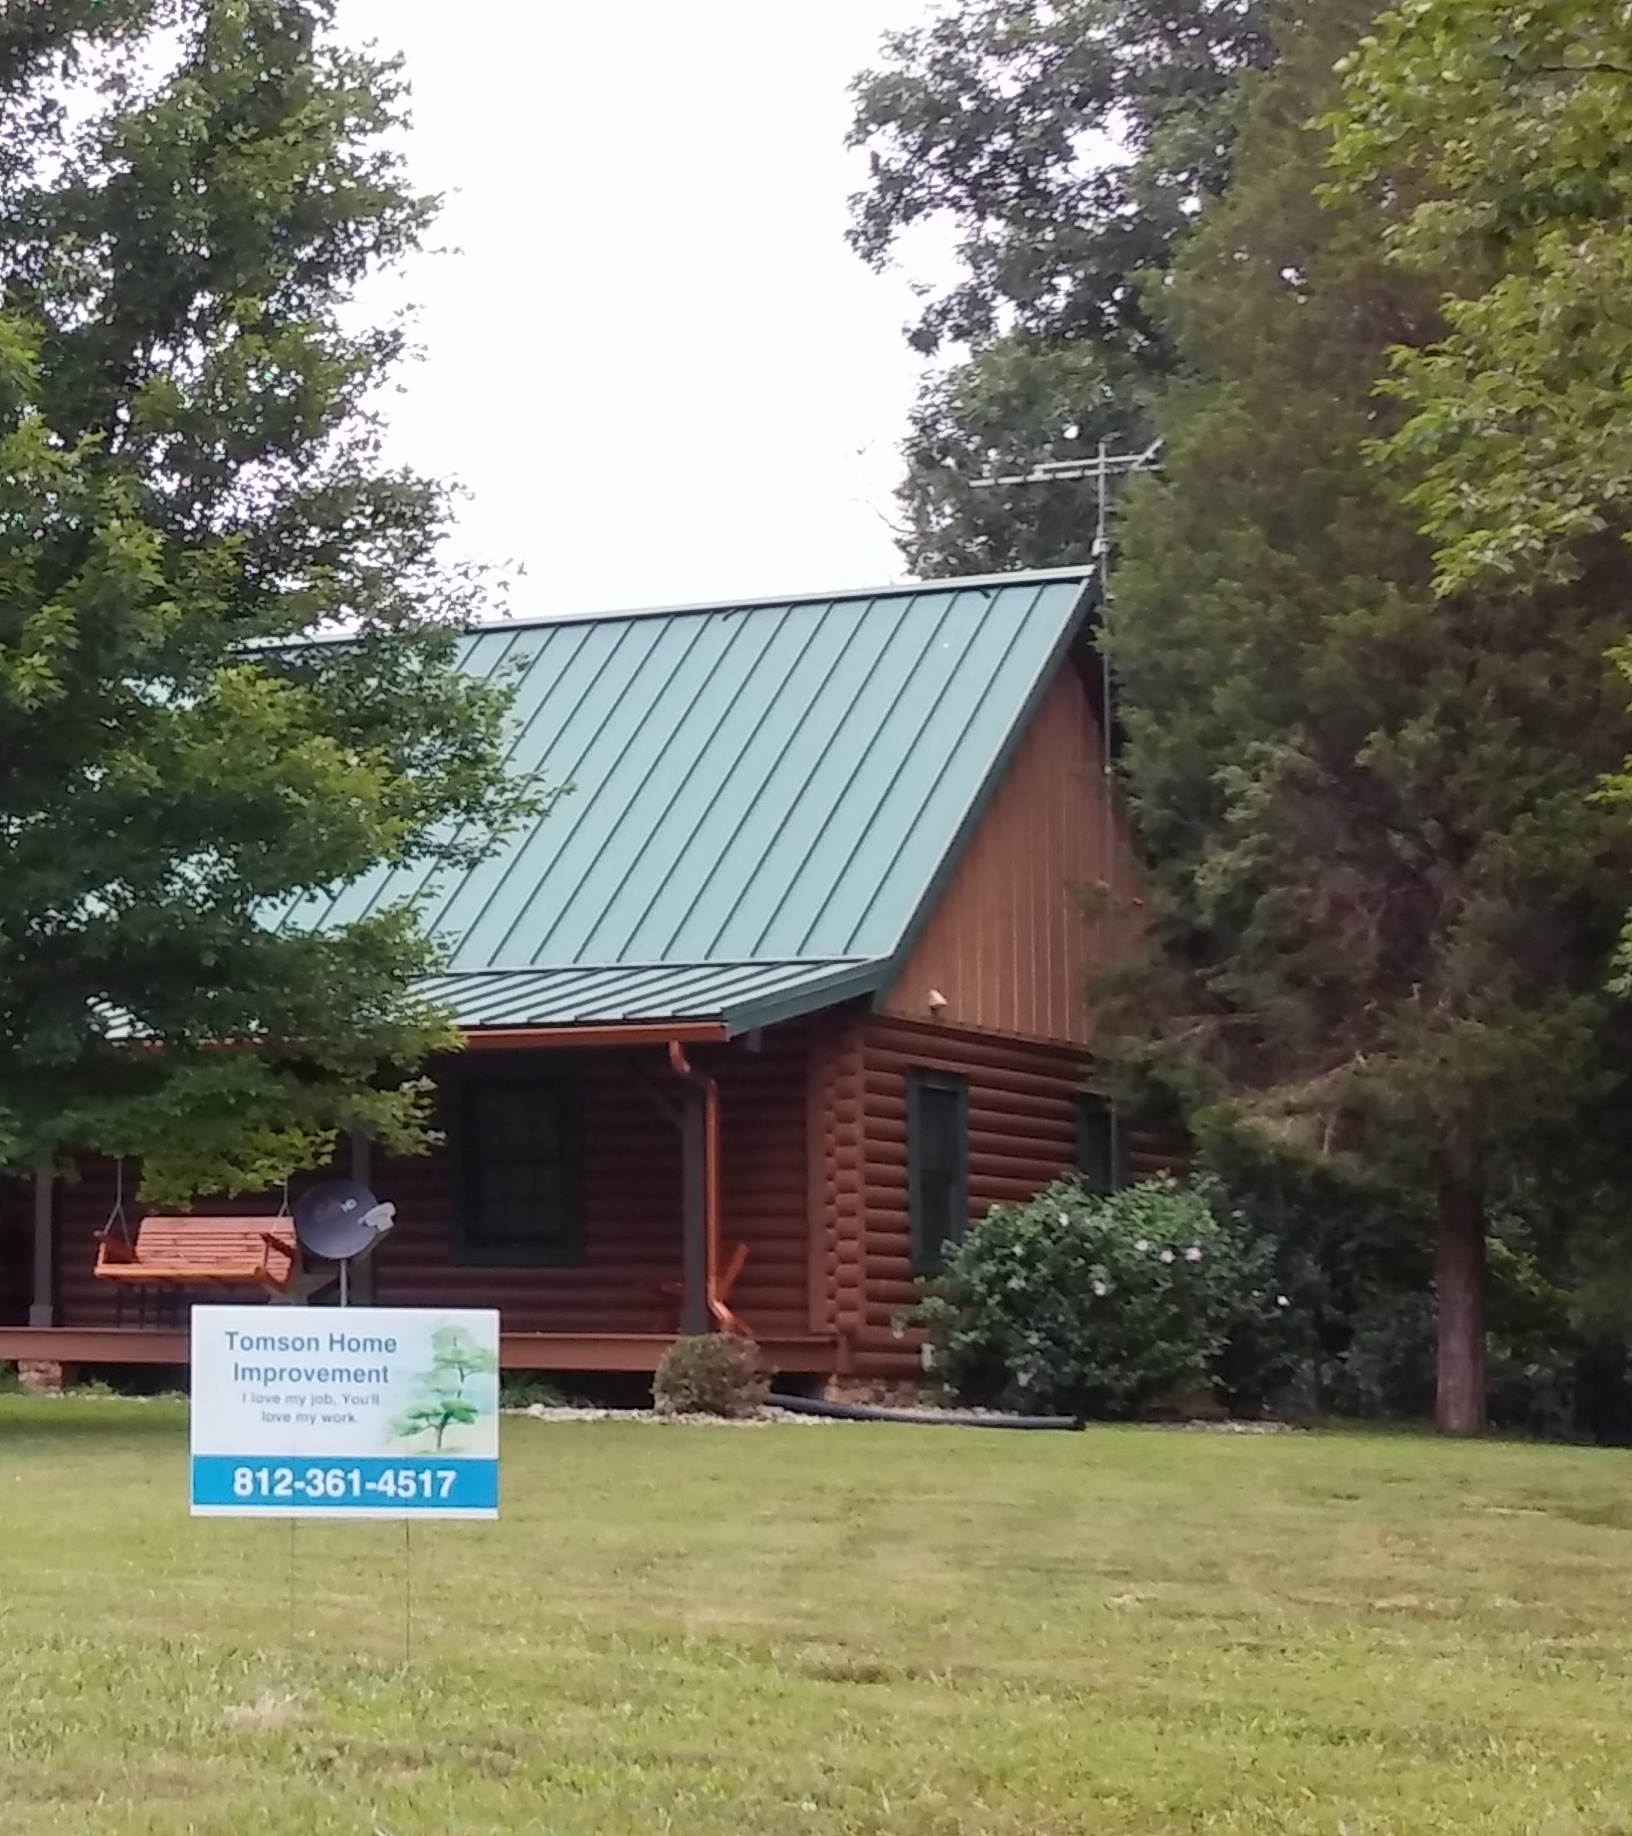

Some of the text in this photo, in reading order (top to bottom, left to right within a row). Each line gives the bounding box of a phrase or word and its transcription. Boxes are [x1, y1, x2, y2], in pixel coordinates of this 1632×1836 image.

[225, 1331, 397, 1353] Tomson Home
[233, 1362, 389, 1386] Improvement
[251, 1391, 281, 1405] love
[285, 1395, 306, 1408] my
[342, 1393, 380, 1406] You'll
[261, 1410, 291, 1423] love
[296, 1413, 317, 1426] my
[233, 1467, 457, 1498] 812-361-4517
